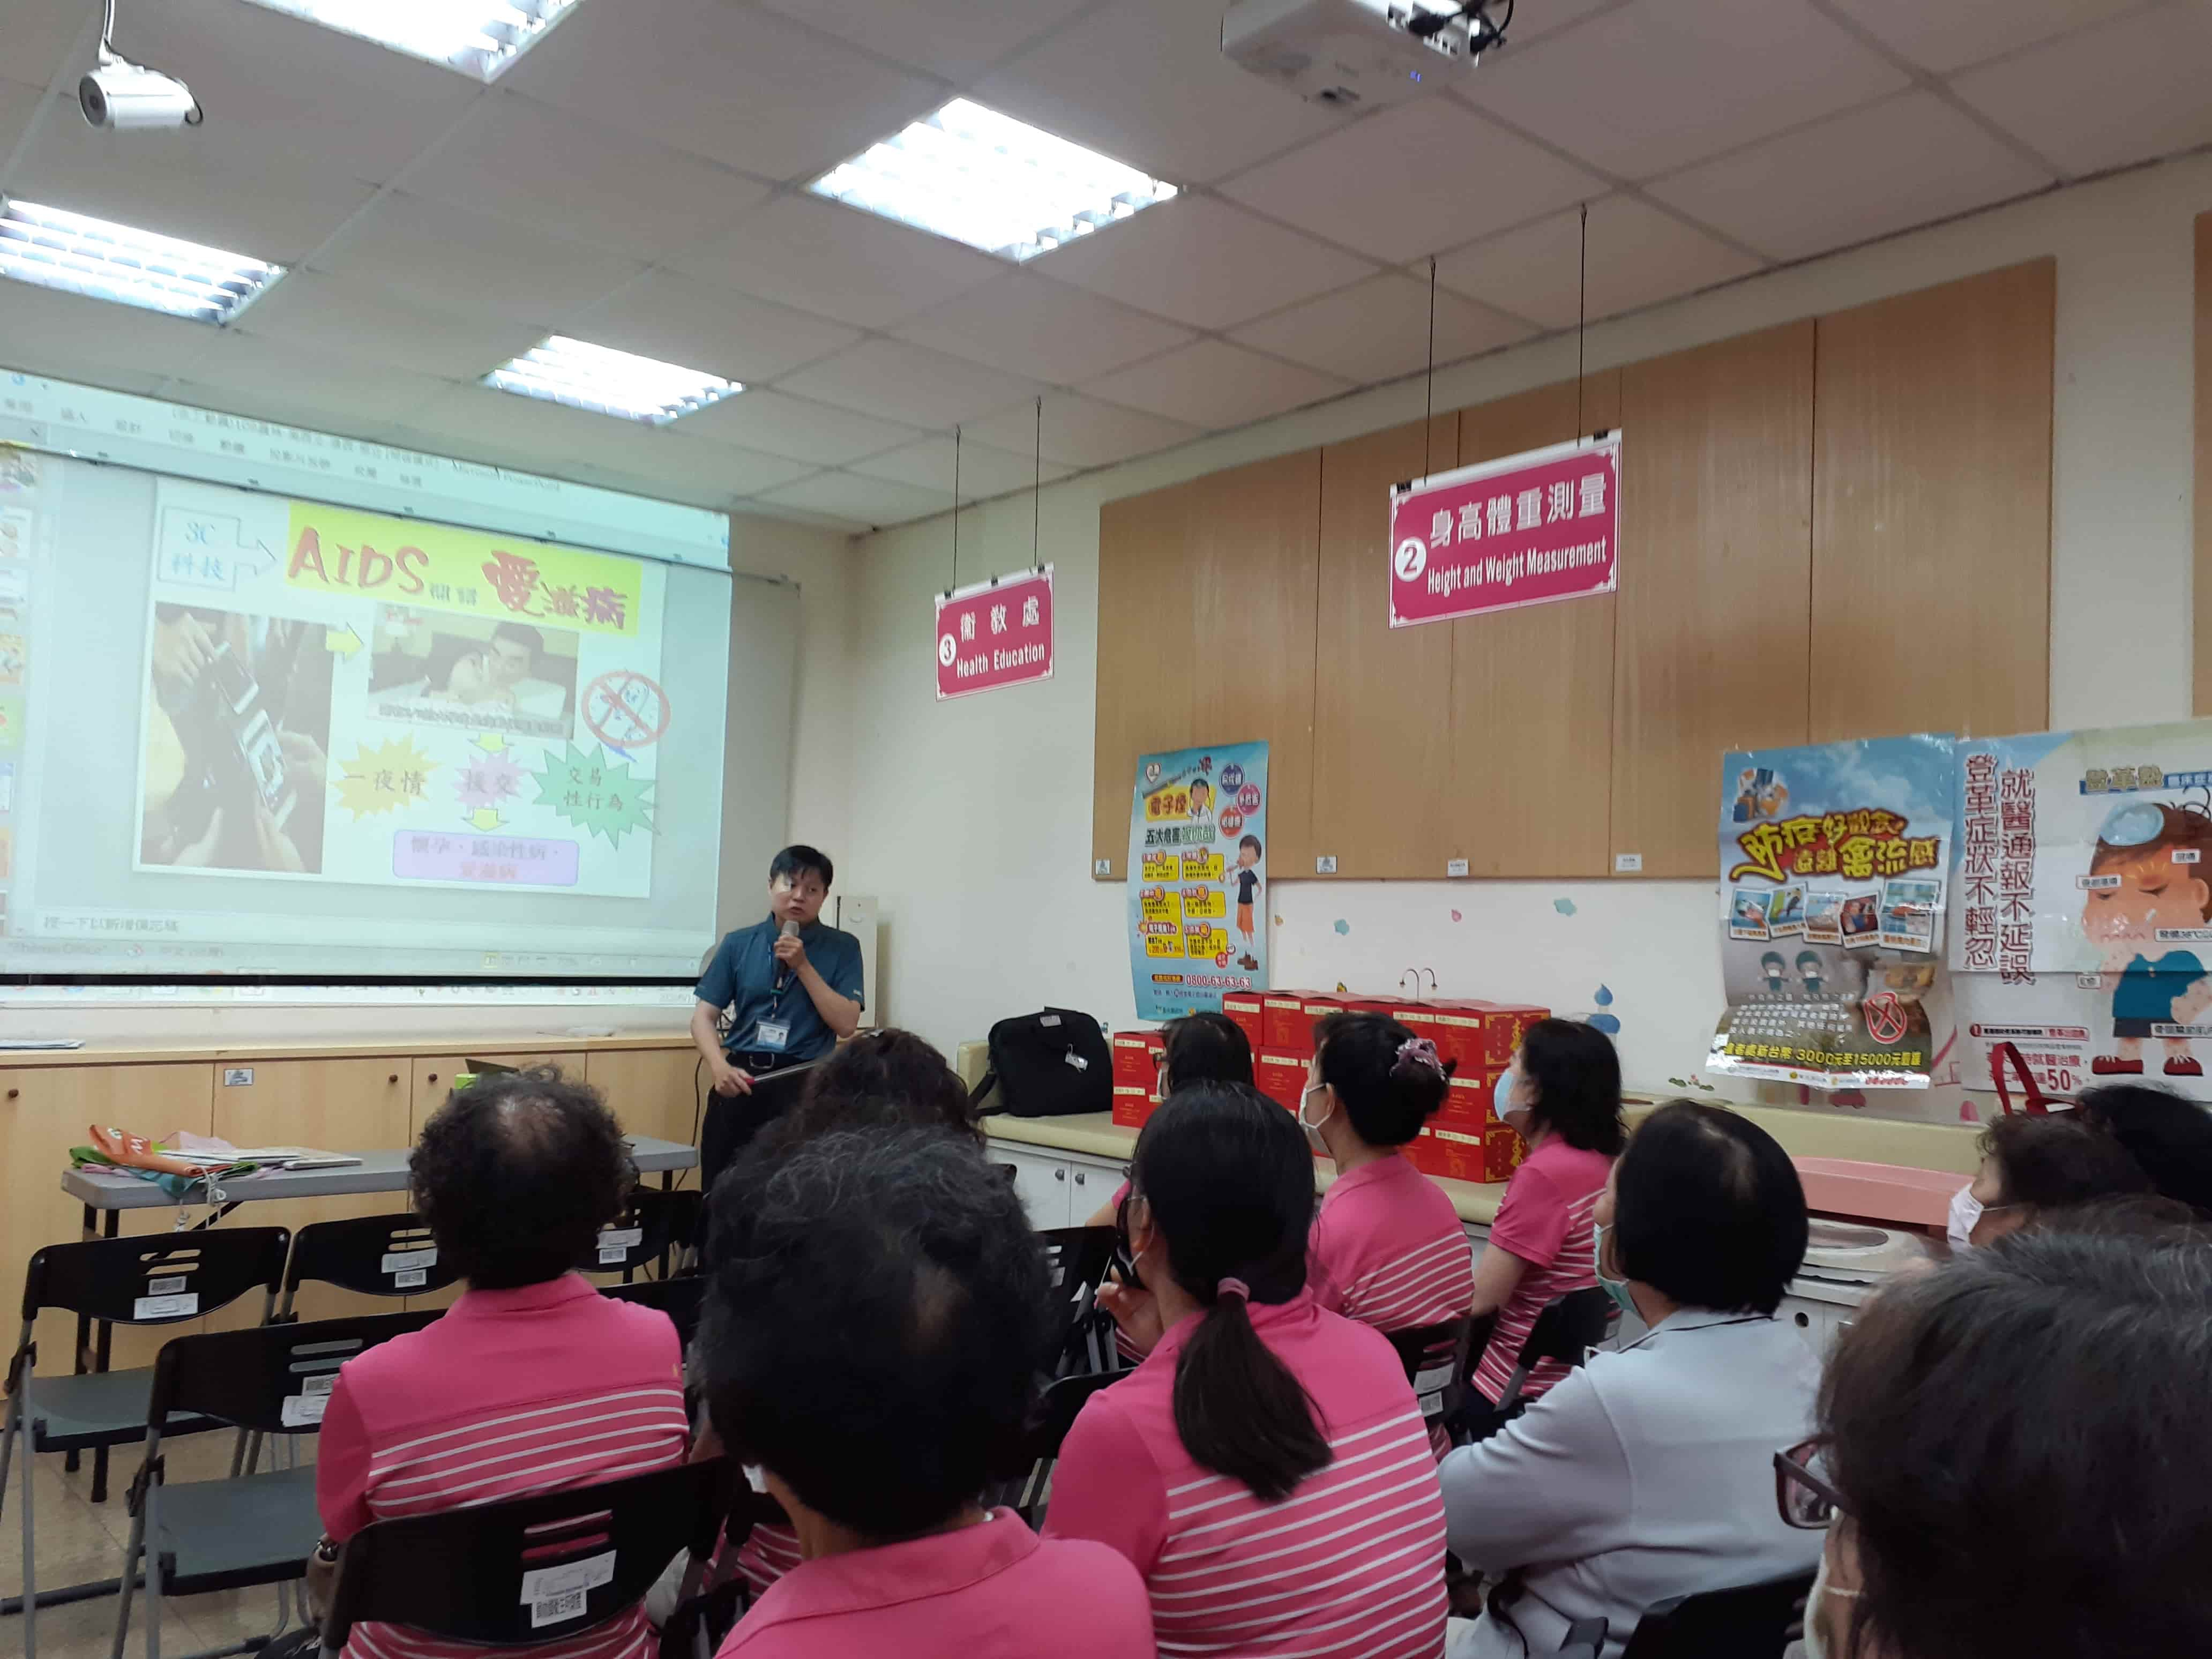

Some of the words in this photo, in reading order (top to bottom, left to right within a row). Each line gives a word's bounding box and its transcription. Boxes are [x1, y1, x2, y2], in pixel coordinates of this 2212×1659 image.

[1430, 472, 1606, 549] 身高體重測量
[288, 525, 429, 594] AIDS
[1428, 564, 1461, 597] Height
[1463, 559, 1482, 589] and
[1486, 547, 1524, 586] Weight
[1527, 535, 1606, 577] Measurement
[956, 653, 989, 678] Health
[993, 641, 1045, 670] Education
[343, 769, 425, 795] 一夜情
[1965, 753, 1998, 969] 登革症狀不輕忽
[2001, 769, 2035, 985] 就醫通報不延誤
[1186, 974, 1252, 989] 0800-63-63-63
